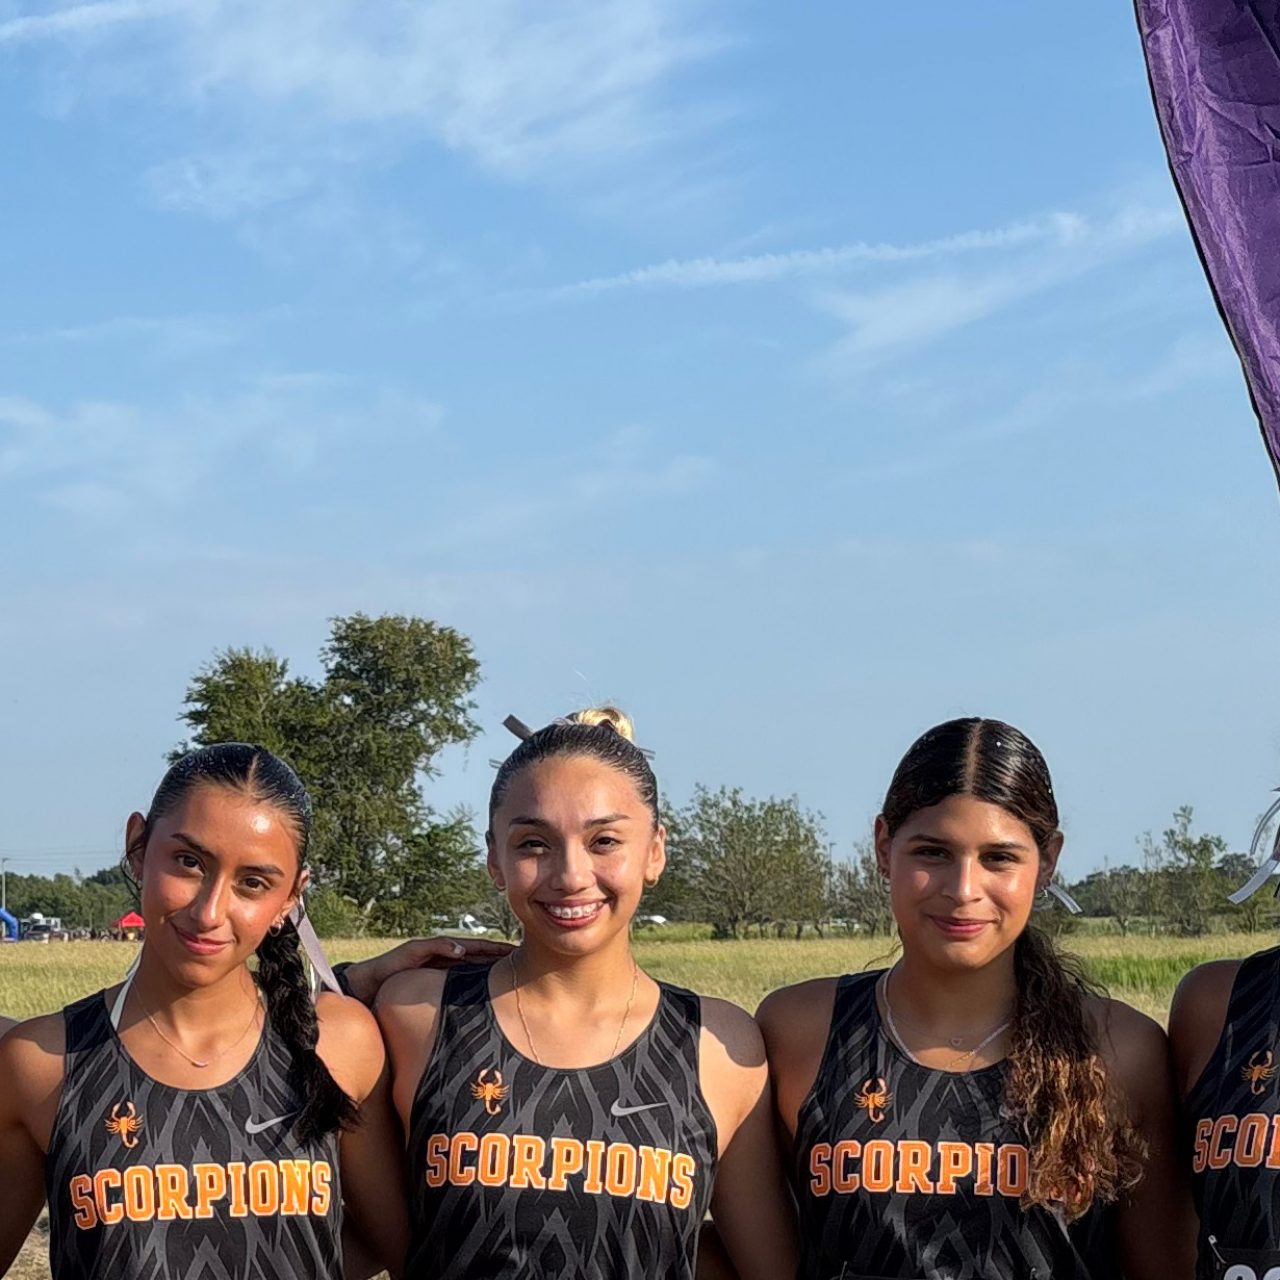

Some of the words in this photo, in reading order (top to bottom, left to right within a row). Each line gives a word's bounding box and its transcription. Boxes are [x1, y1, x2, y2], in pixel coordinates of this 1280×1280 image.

[70, 1159, 331, 1230] SCORPIONS
[426, 1132, 696, 1210] SCORPIONS
[809, 1140, 1028, 1198] SCORPIO
